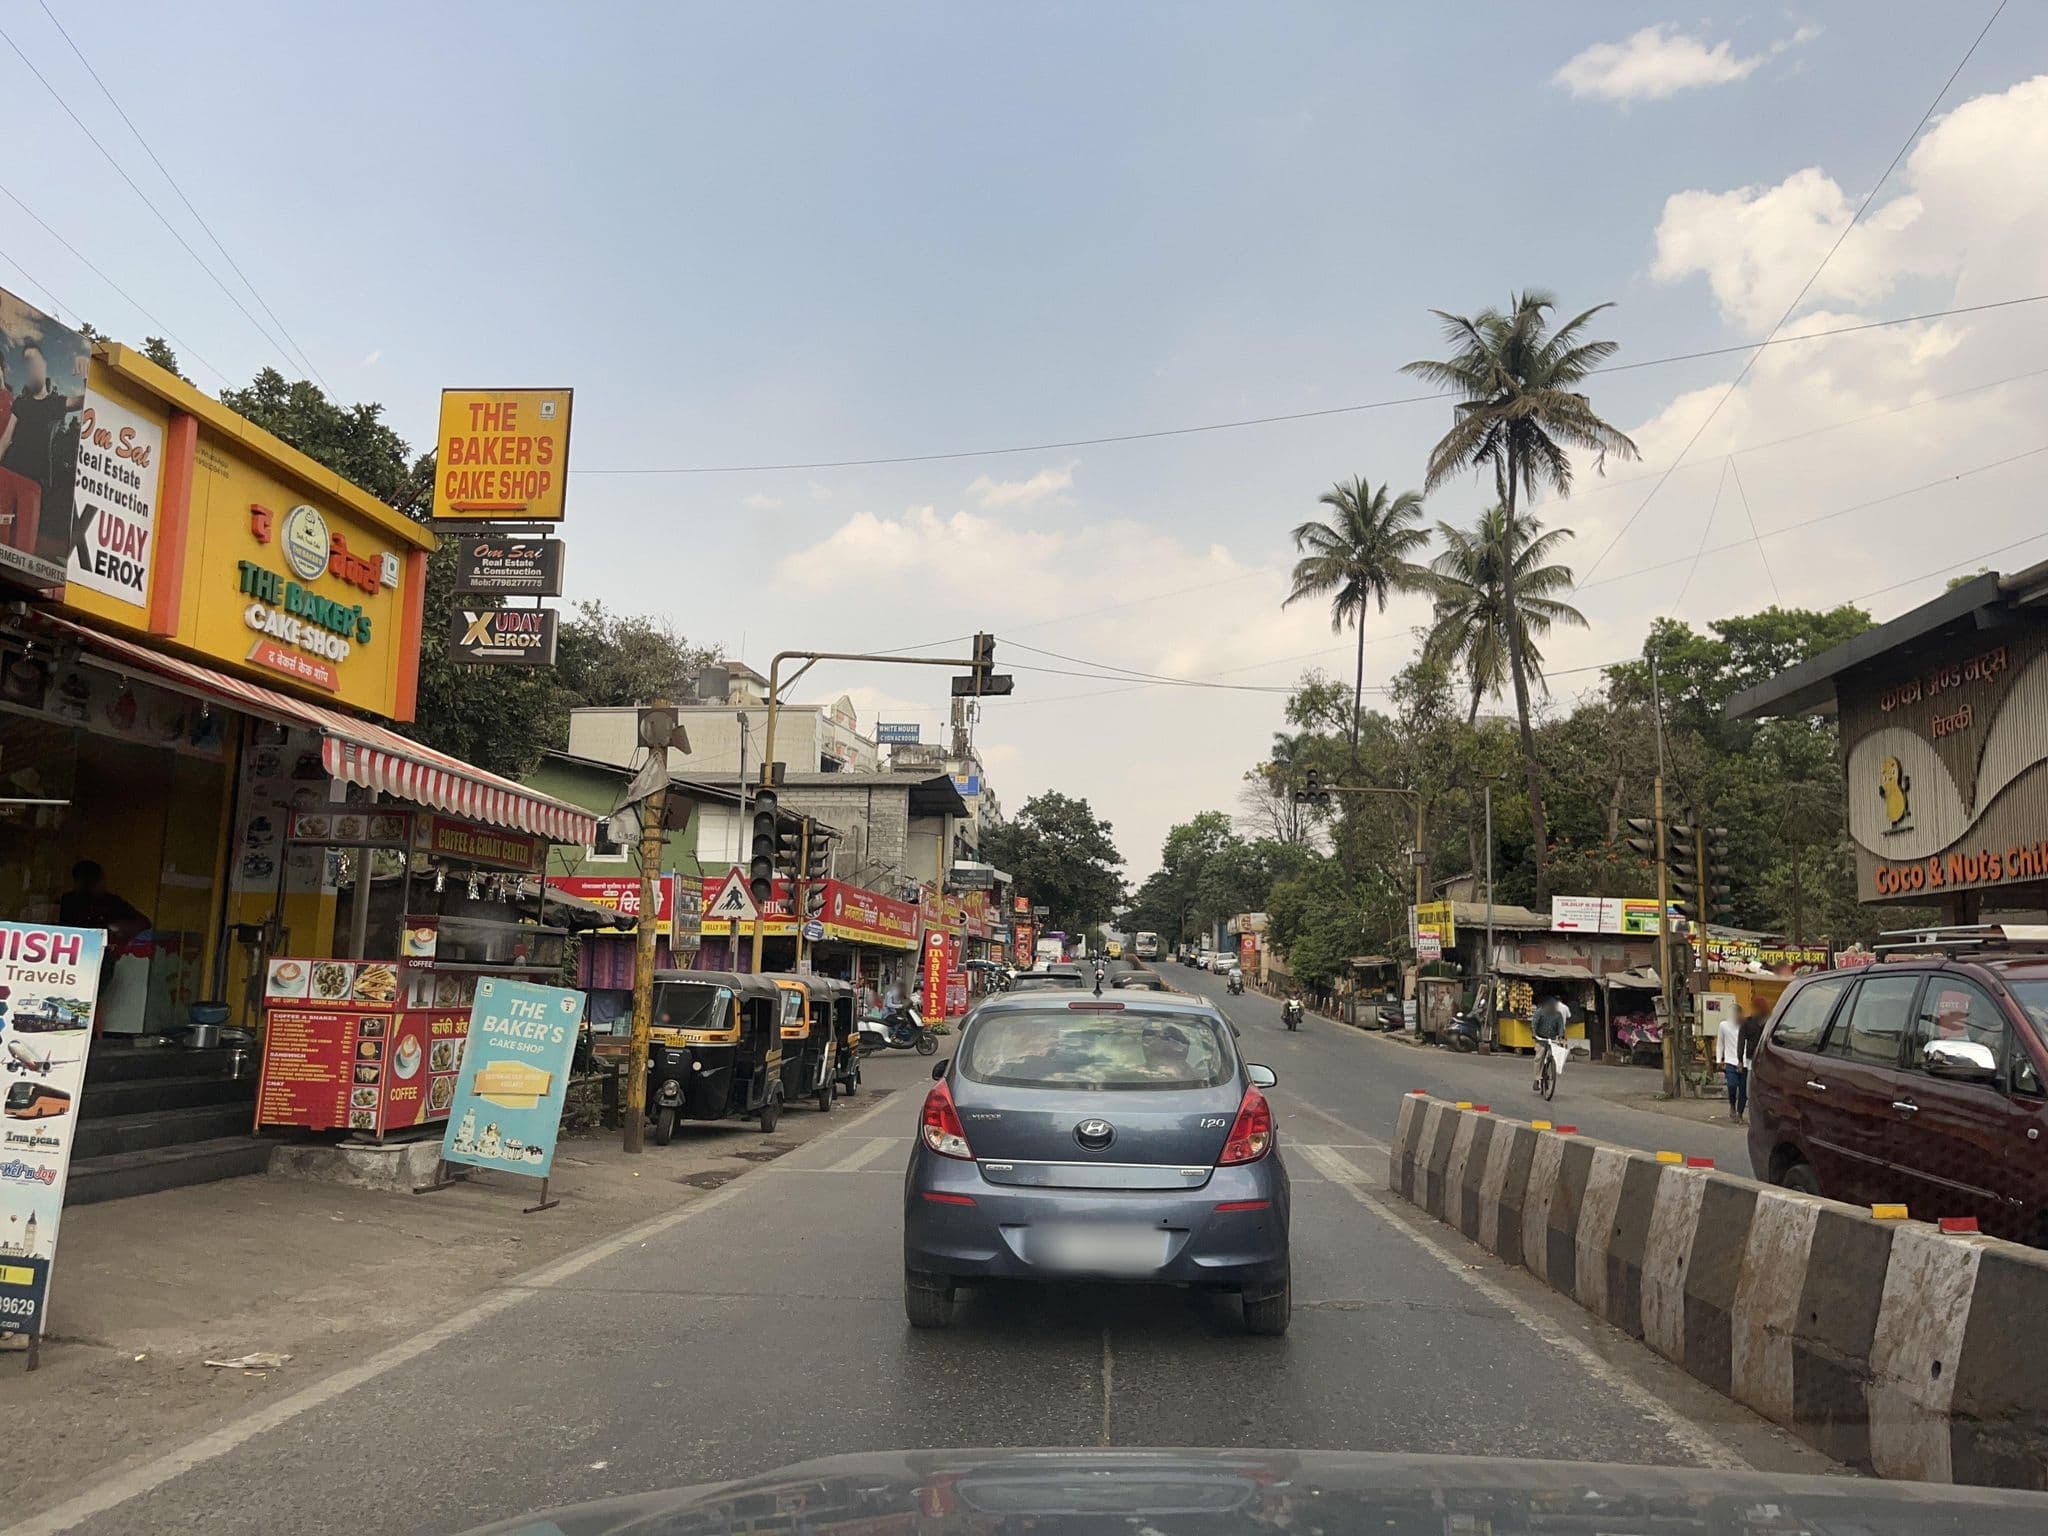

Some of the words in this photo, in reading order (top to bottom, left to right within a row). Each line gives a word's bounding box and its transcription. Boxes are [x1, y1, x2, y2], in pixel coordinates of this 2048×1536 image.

[469, 403, 518, 432] THE
[447, 436, 553, 465] BAKER'S
[104, 457, 141, 490] Estate
[445, 471, 495, 500] CAKE
[499, 470, 551, 500] SHOP
[98, 510, 149, 563] UDAY
[473, 543, 504, 558] Om
[508, 544, 544, 559] Sai
[36, 562, 66, 582] SPORTS
[473, 567, 481, 575] &
[483, 567, 542, 575] Construction
[482, 558, 503, 567] Real
[505, 558, 535, 567] Estate
[238, 560, 284, 605] THE
[285, 581, 373, 645] BAKER'S
[244, 603, 301, 644] CAKE
[301, 625, 350, 663] SHOP
[495, 612, 544, 632] UDAY
[438, 828, 469, 853] COFFEE
[502, 842, 529, 864] CENTER
[1874, 863, 1925, 894] Coco
[1929, 855, 1944, 887] &
[1949, 848, 2002, 883] Nuts
[6, 965, 77, 985] Travels
[408, 960, 433, 969] COFFEE
[510, 998, 548, 1020] THE
[482, 1015, 565, 1044] BAKER'S
[489, 1037, 517, 1051] CAKE
[517, 1041, 544, 1055] SHOP
[390, 1086, 418, 1101] COFFEE
[5, 1131, 60, 1148] Imagicaa
